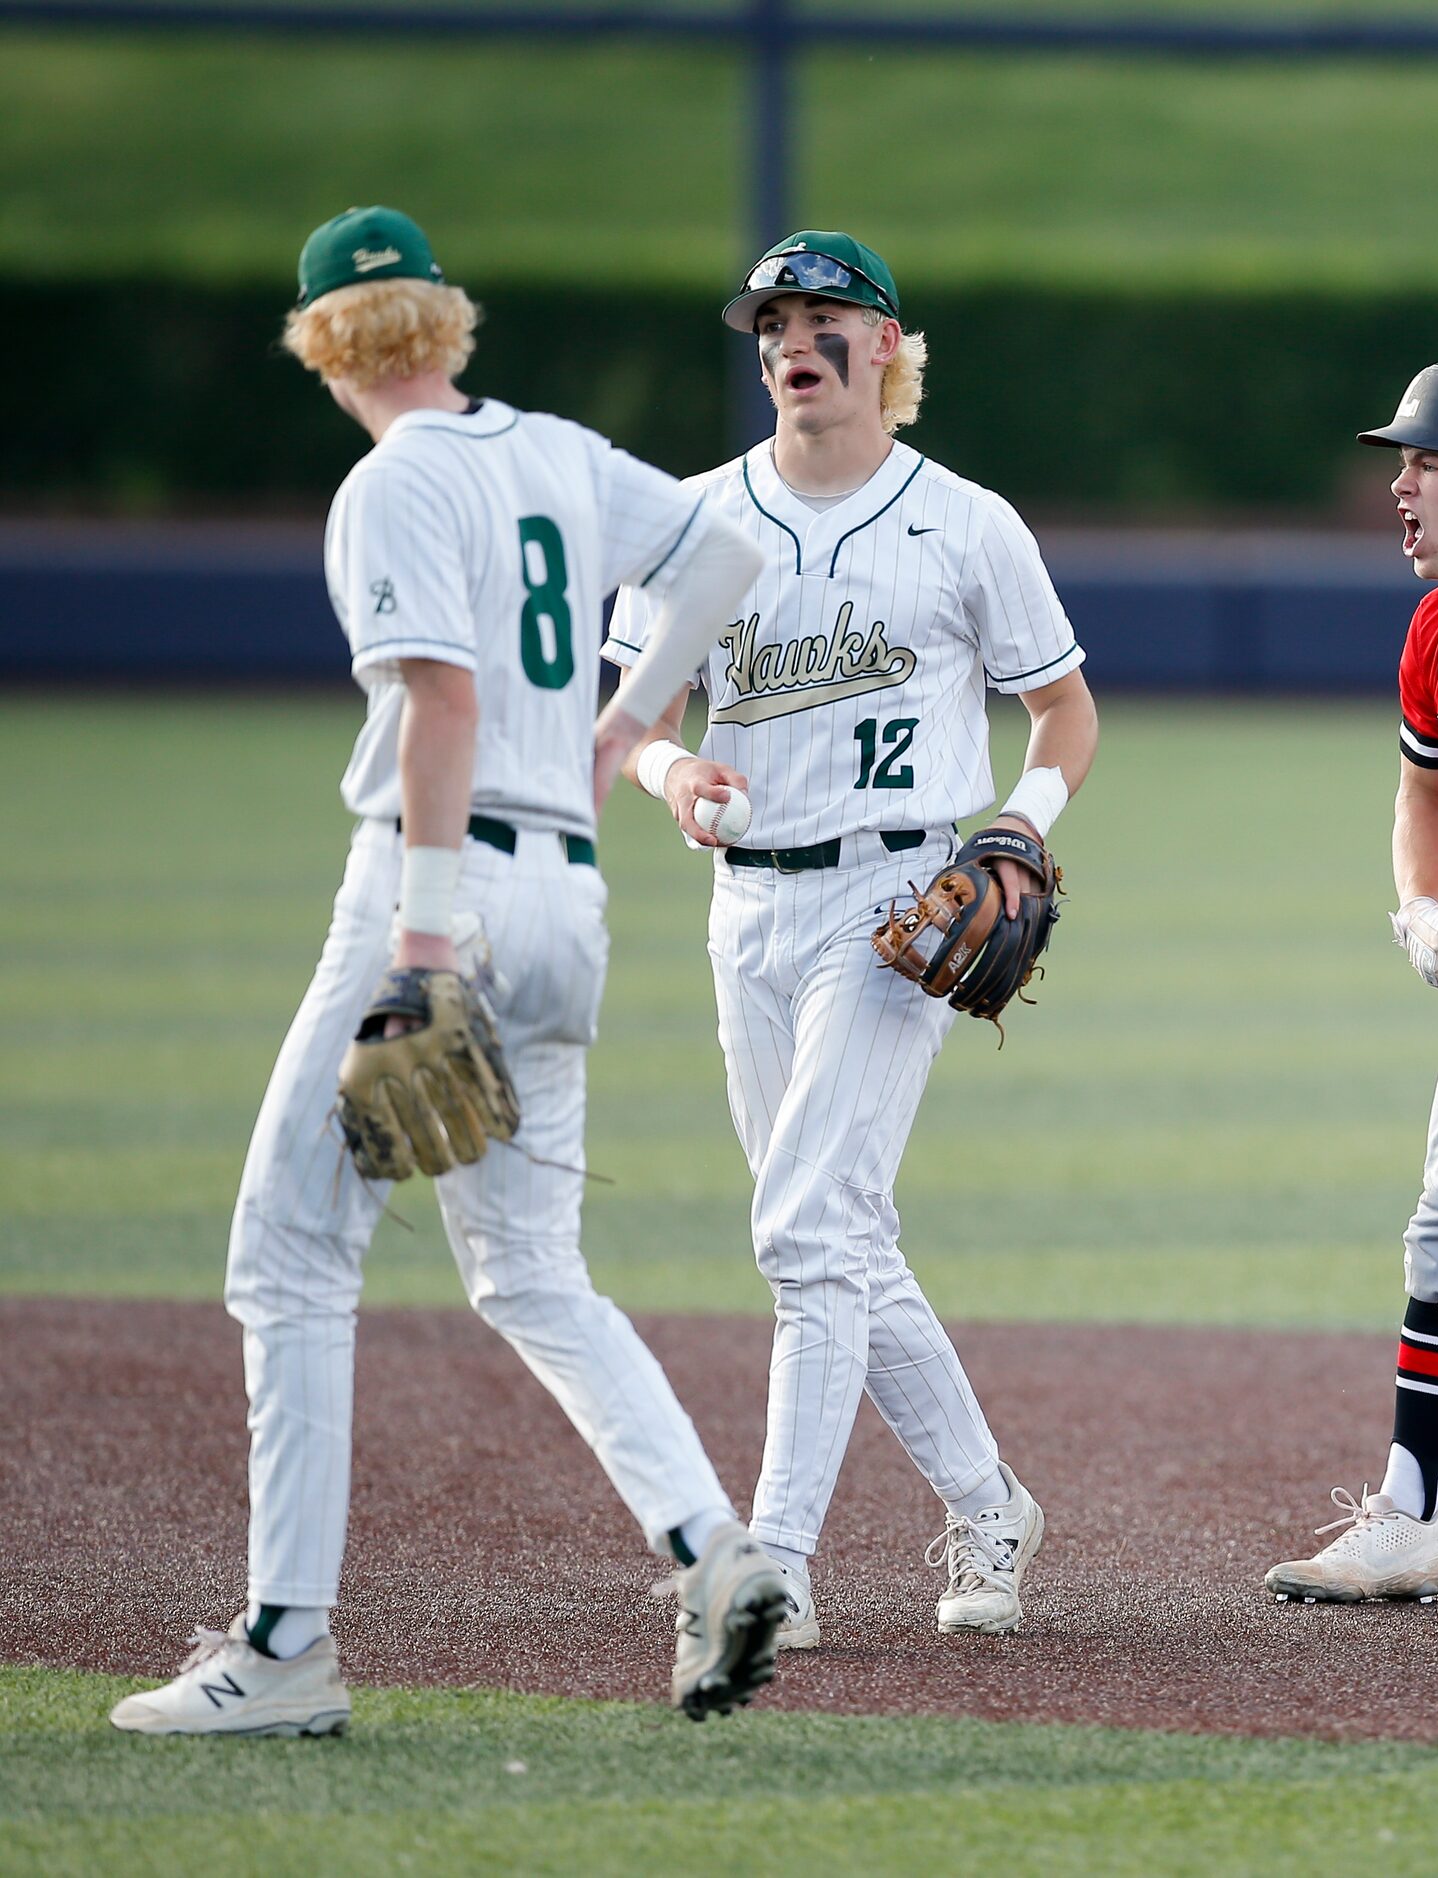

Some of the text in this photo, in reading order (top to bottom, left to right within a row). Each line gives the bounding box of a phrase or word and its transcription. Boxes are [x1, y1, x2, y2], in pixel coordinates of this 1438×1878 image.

[518, 516, 573, 689] 8
[719, 601, 917, 694] Hawks
[854, 718, 920, 789] 12
[976, 836, 1027, 851] Wilson
[949, 942, 973, 974] A2K
[201, 1672, 246, 1708] N
